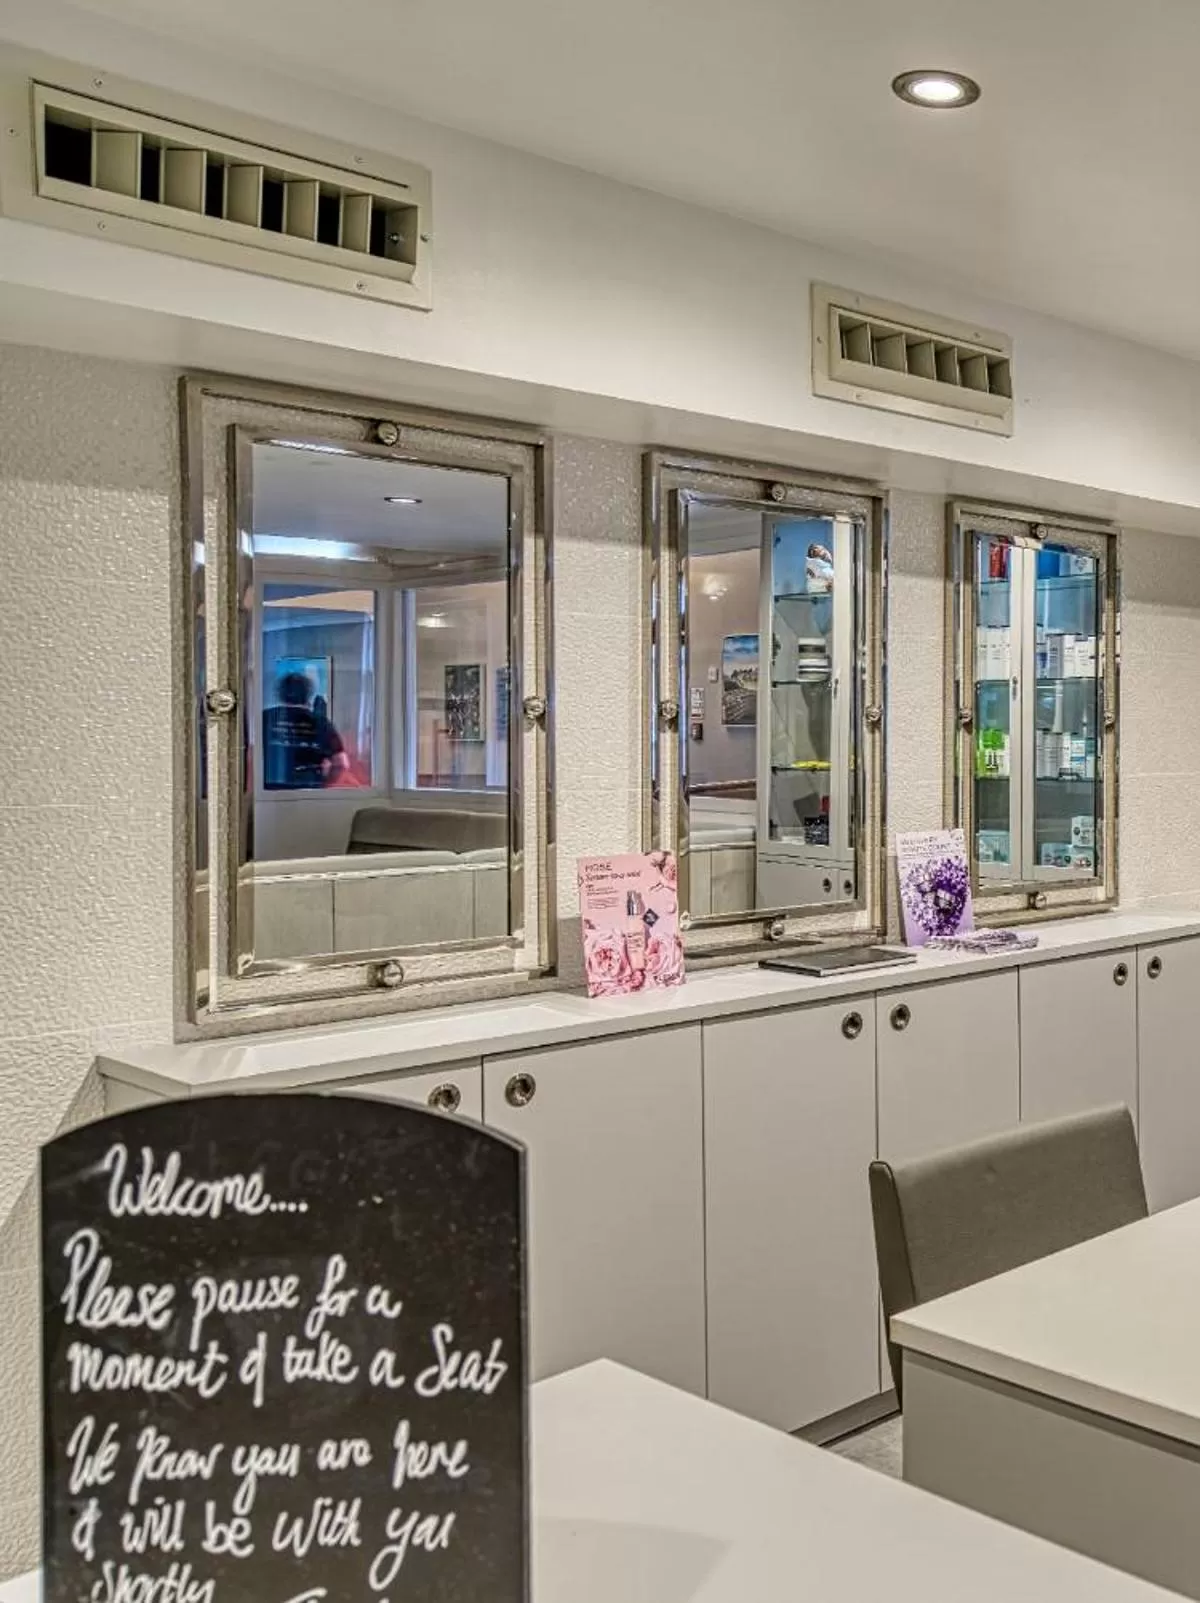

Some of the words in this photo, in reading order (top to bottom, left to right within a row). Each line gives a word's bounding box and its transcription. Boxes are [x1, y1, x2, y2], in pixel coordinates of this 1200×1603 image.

[60, 1227, 176, 1330] Please
[190, 1275, 300, 1352] pause
[304, 1253, 359, 1340] for
[365, 1284, 403, 1319] a
[282, 1330, 360, 1384] take
[368, 1348, 406, 1388] a
[65, 1415, 121, 1495] We
[231, 1443, 301, 1516] you
[316, 1438, 374, 1471] are
[392, 1419, 471, 1490] here
[119, 1496, 186, 1554] will
[201, 1500, 256, 1558] be
[368, 1507, 457, 1592] you
